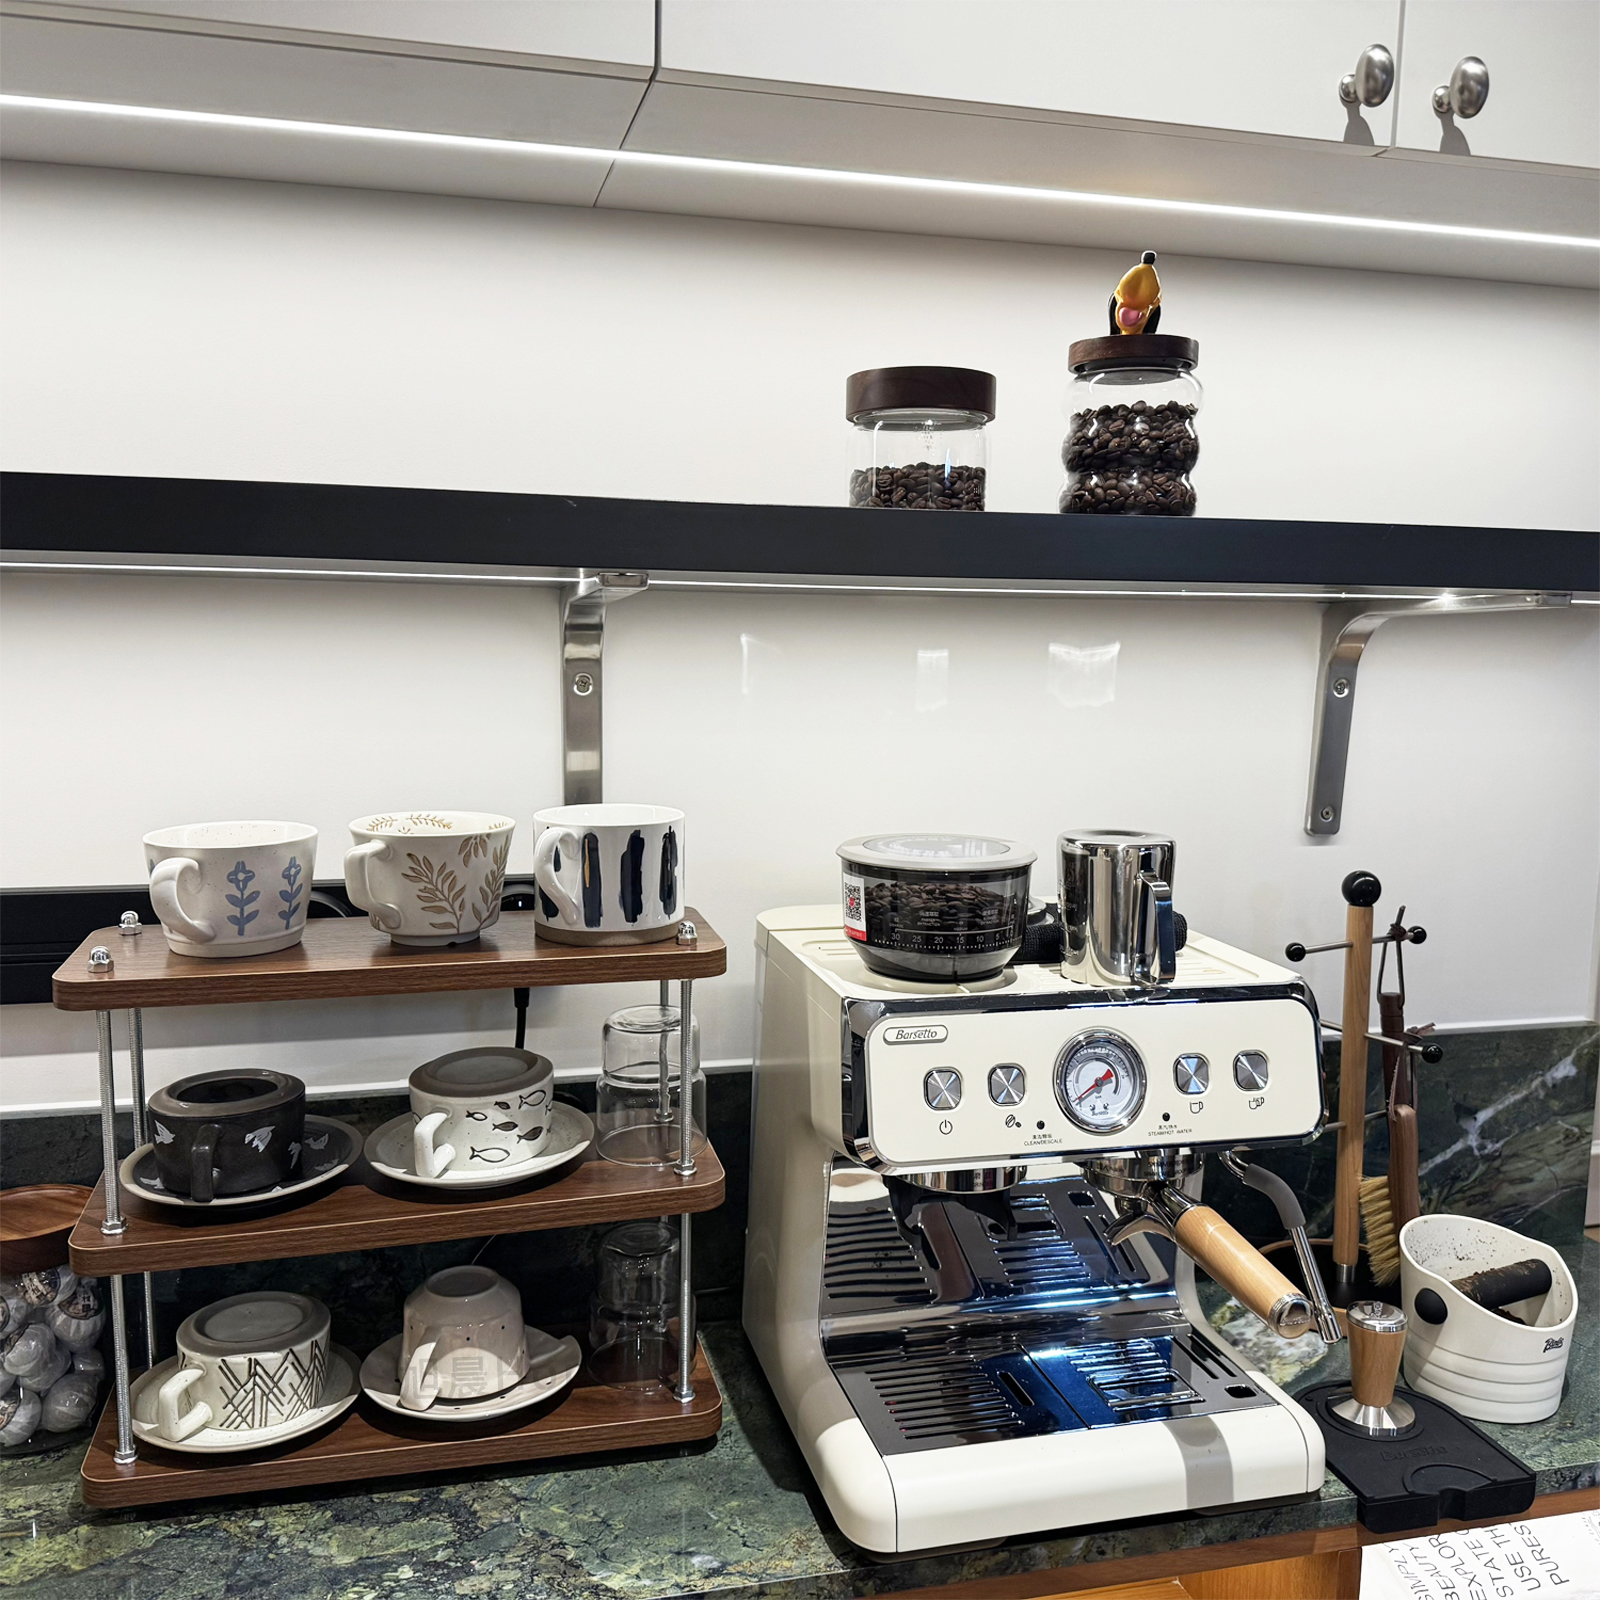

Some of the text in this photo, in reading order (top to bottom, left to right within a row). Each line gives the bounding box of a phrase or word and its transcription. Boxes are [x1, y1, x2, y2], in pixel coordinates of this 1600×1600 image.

[891, 933, 901, 941] 30
[912, 935, 922, 943] 25
[934, 936, 944, 944] 20
[956, 936, 965, 944] 15
[976, 935, 985, 943] 10
[895, 1029, 938, 1040] Barsetto
[1463, 1539, 1514, 1598] STATE
[1504, 1551, 1541, 1591] USE
[1508, 1523, 1570, 1585] PURES
